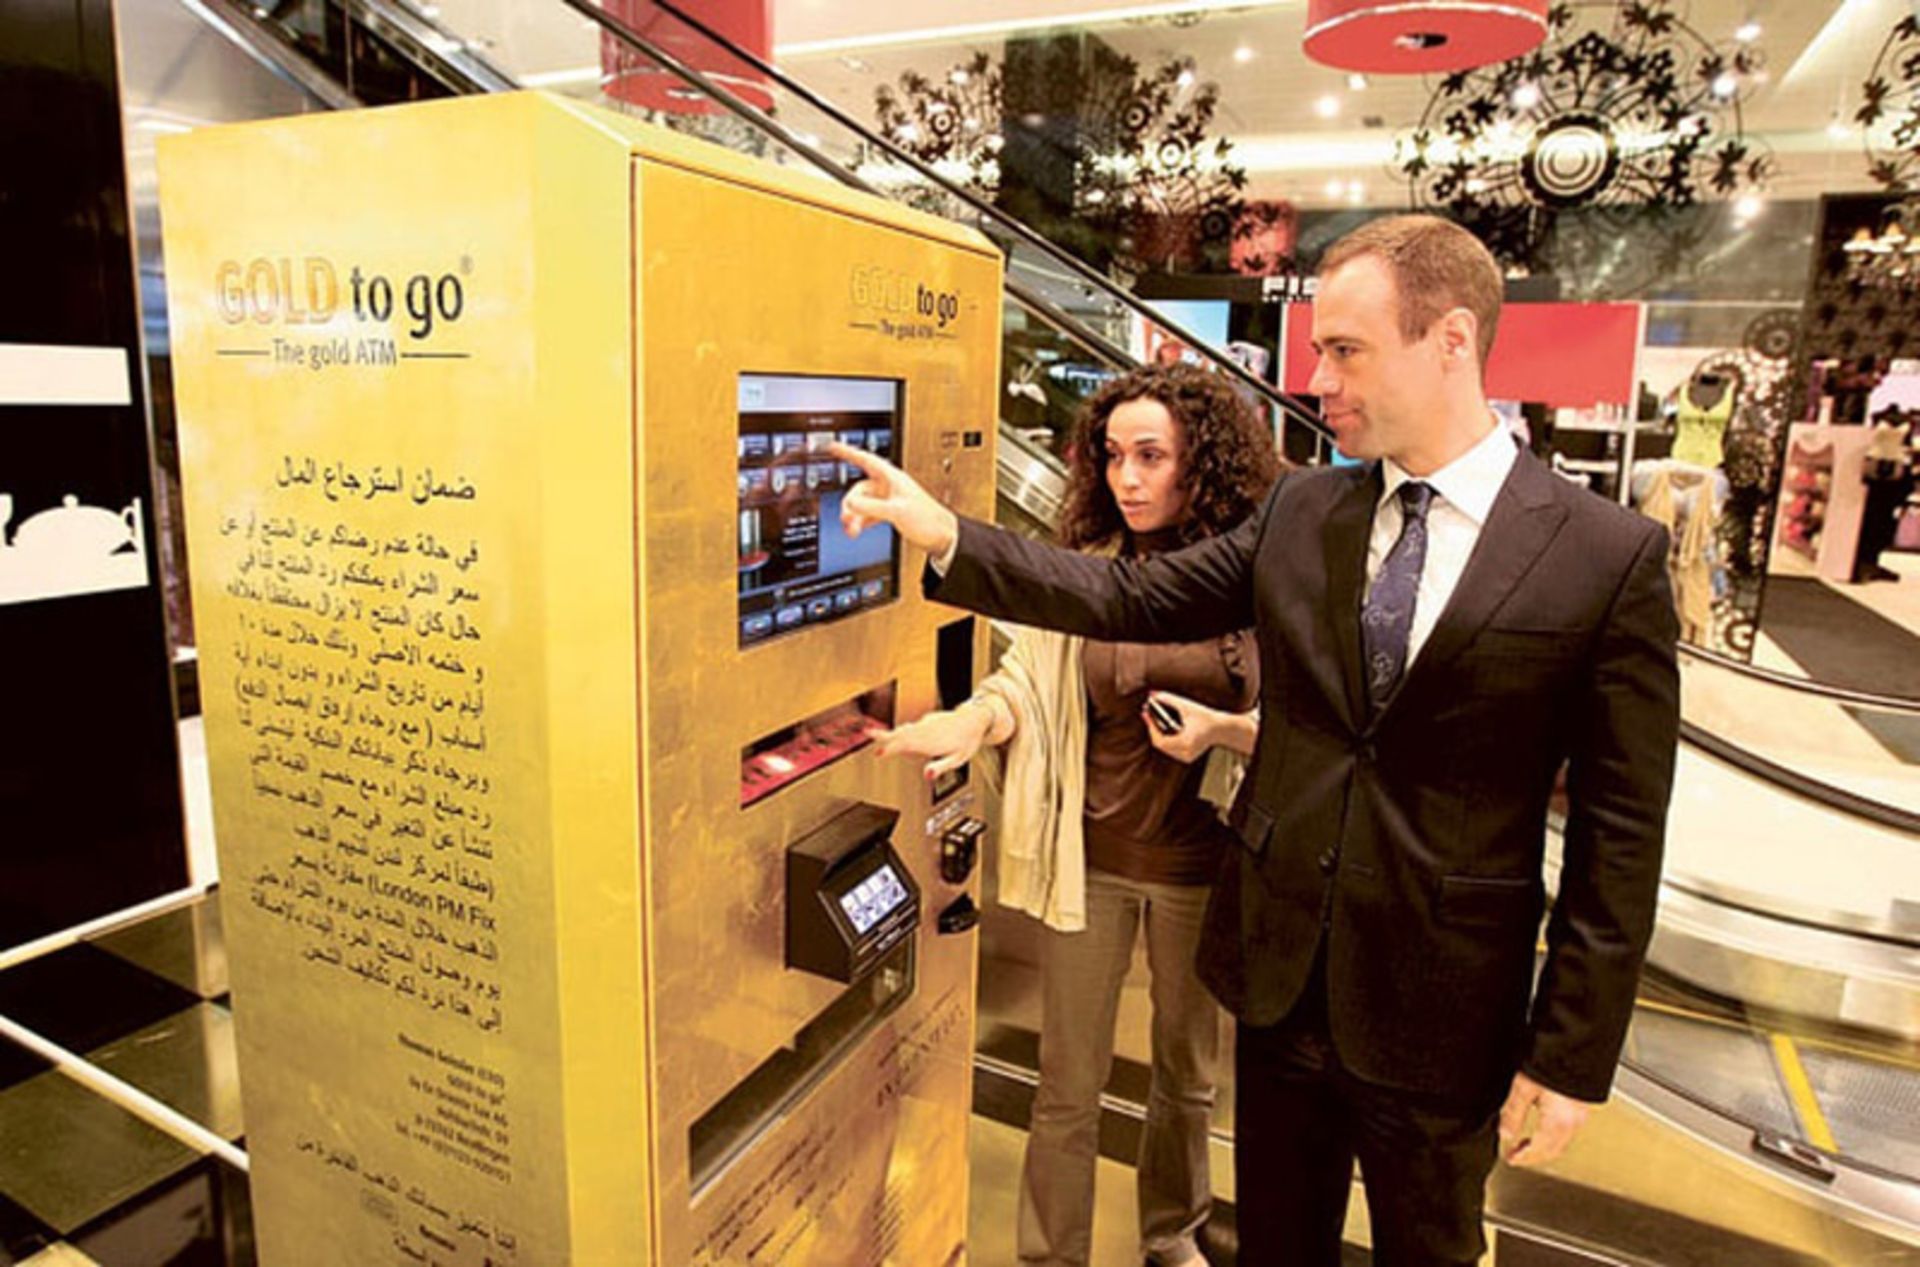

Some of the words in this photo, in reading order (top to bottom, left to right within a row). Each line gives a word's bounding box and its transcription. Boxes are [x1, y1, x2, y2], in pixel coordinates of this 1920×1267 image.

[215, 257, 339, 324] GOLD
[351, 267, 393, 322] to
[917, 283, 935, 316] to
[273, 339, 304, 364] The
[309, 340, 350, 370] gold
[355, 340, 397, 366] ATM
[276, 455, 316, 488] المال
[323, 462, 403, 502] استرجاع
[411, 468, 476, 506] ضمان
[436, 895, 465, 921] PM
[469, 907, 496, 932] Fix
